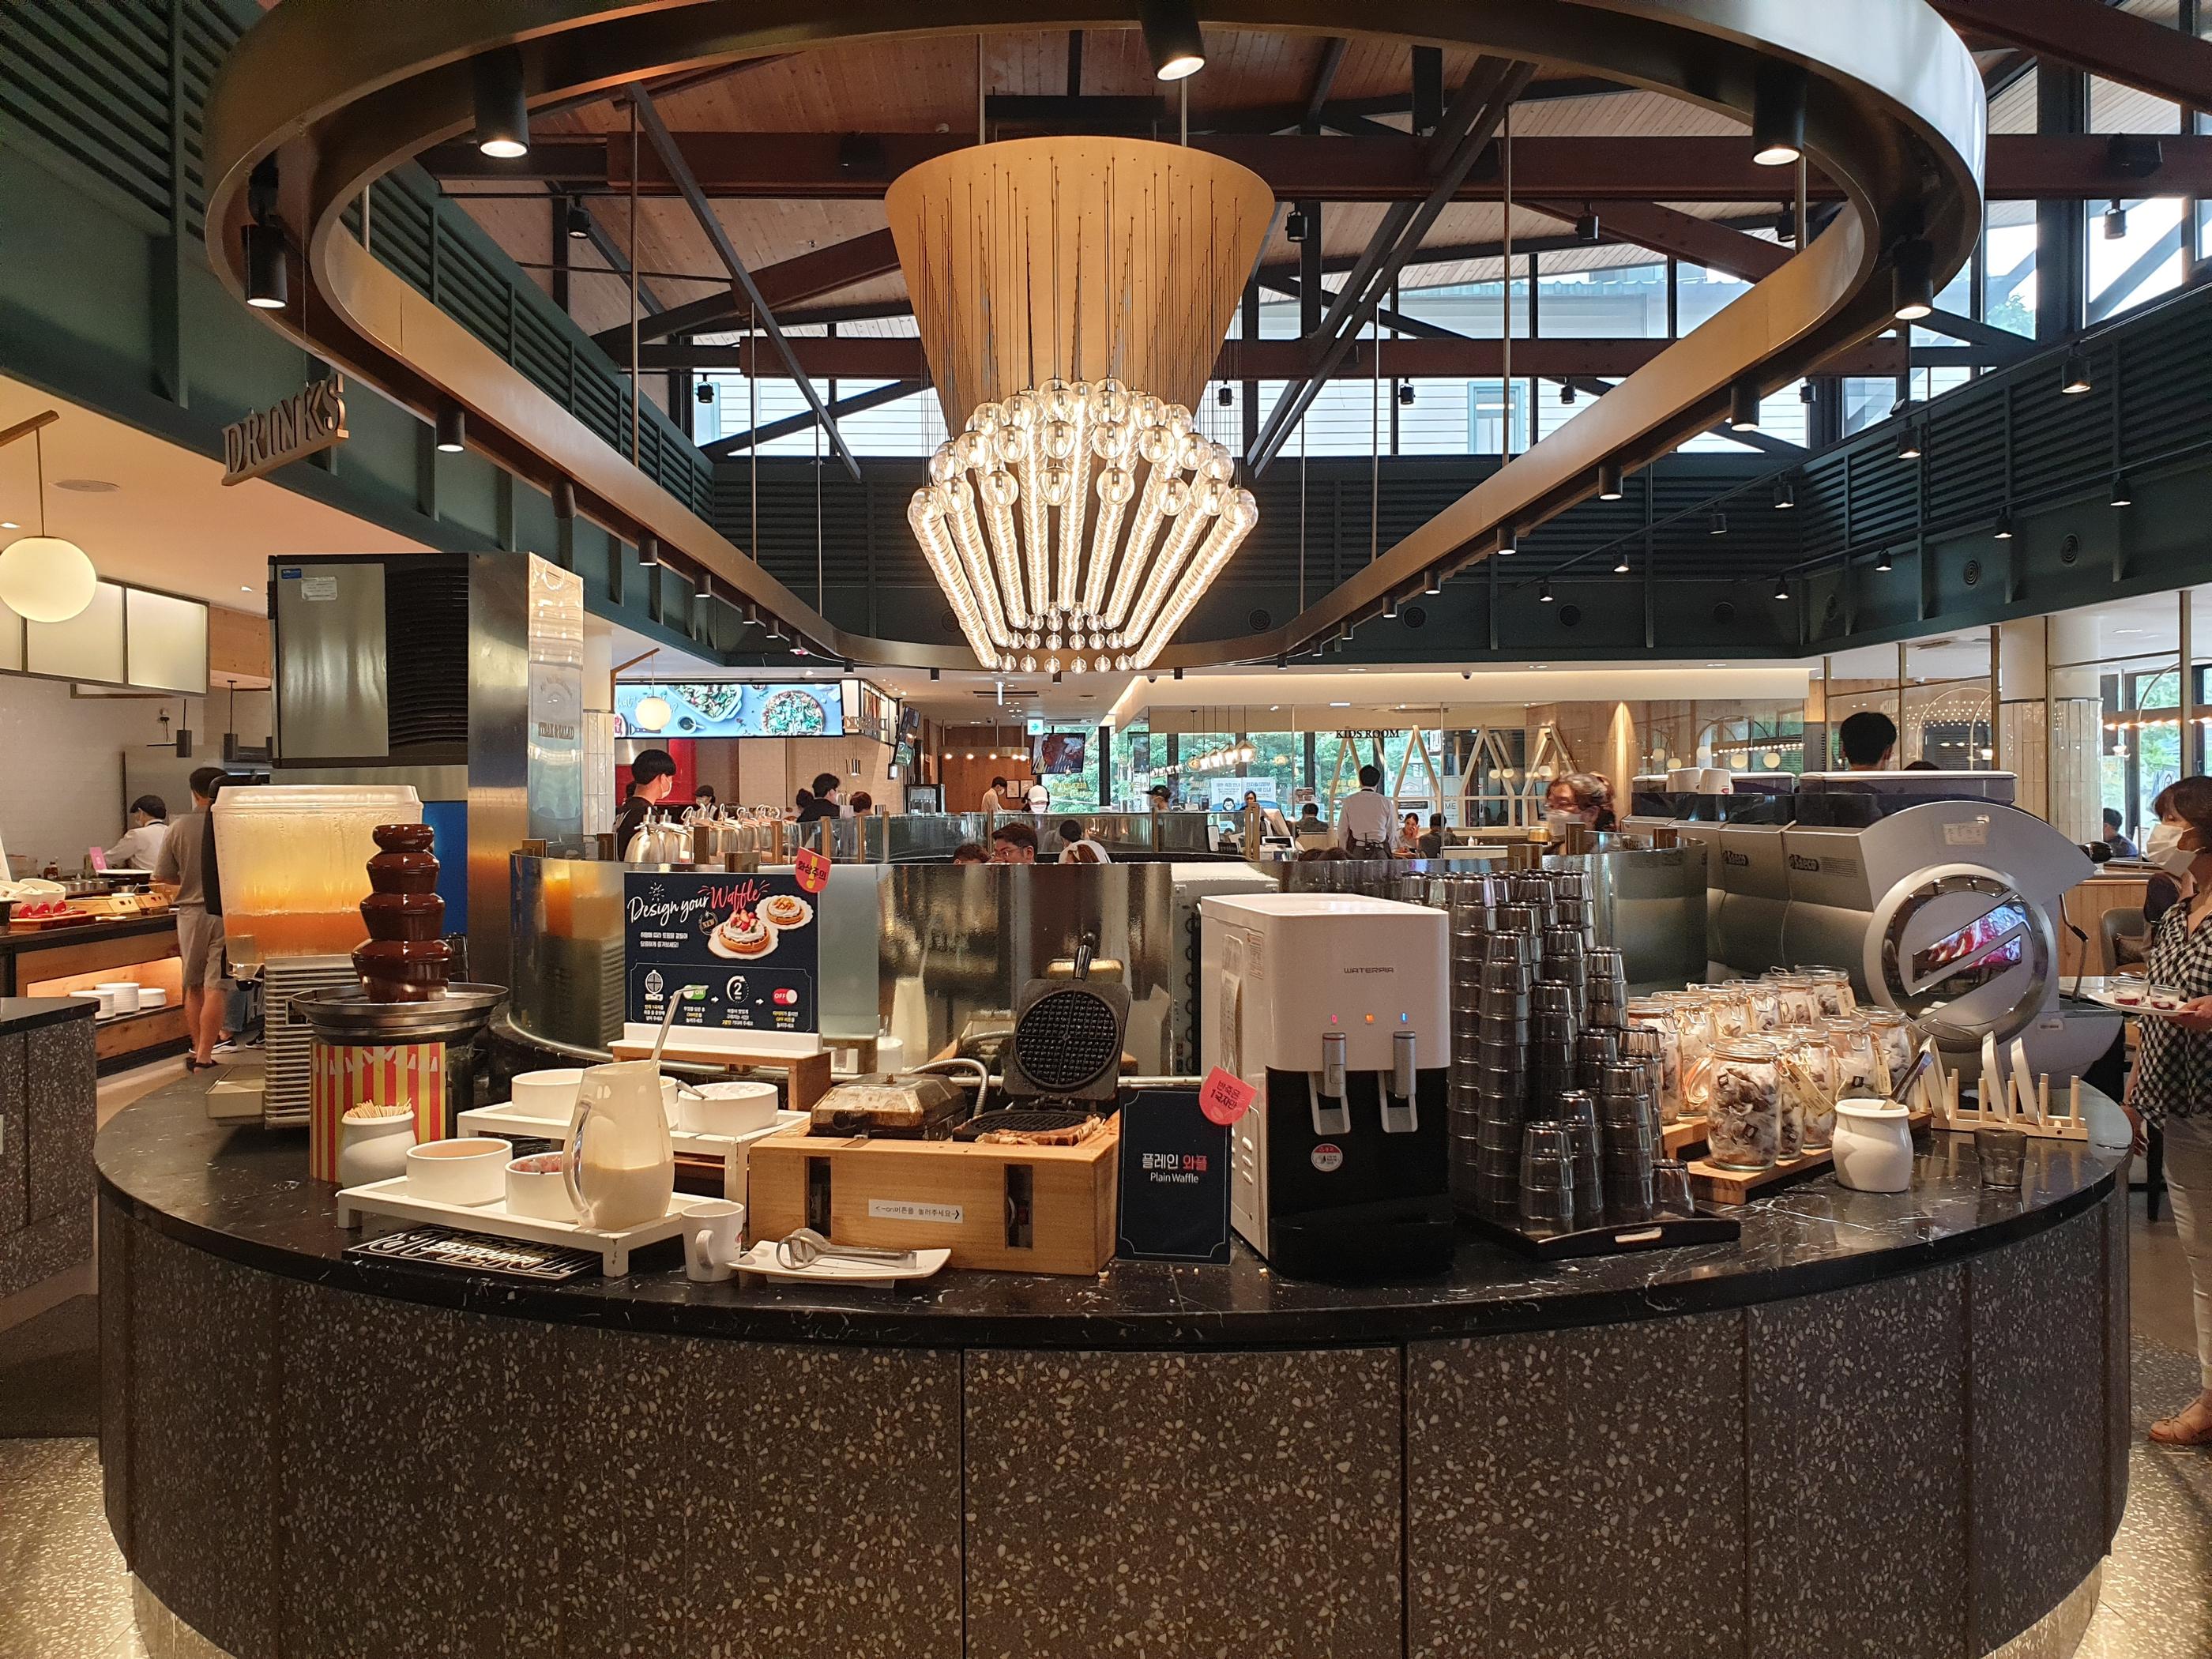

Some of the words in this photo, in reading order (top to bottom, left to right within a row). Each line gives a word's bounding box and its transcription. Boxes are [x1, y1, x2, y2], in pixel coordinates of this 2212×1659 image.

[224, 374, 347, 479] DRINKS
[1335, 730, 1362, 739] KIDS
[1365, 729, 1400, 739] ROOM
[798, 861, 827, 881] 화상주의
[1794, 855, 1819, 871] Saeco
[627, 896, 679, 927] Design
[680, 894, 710, 924] your
[710, 878, 762, 911] Waffle
[734, 982, 742, 995] 2
[1210, 1089, 1237, 1110] 1국자만
[1217, 1080, 1240, 1100] 반죽은
[1142, 1153, 1179, 1170] 플레인
[1183, 1154, 1208, 1172] 와플
[1150, 1172, 1171, 1183] Plain
[1172, 1173, 1199, 1183] Waffle
